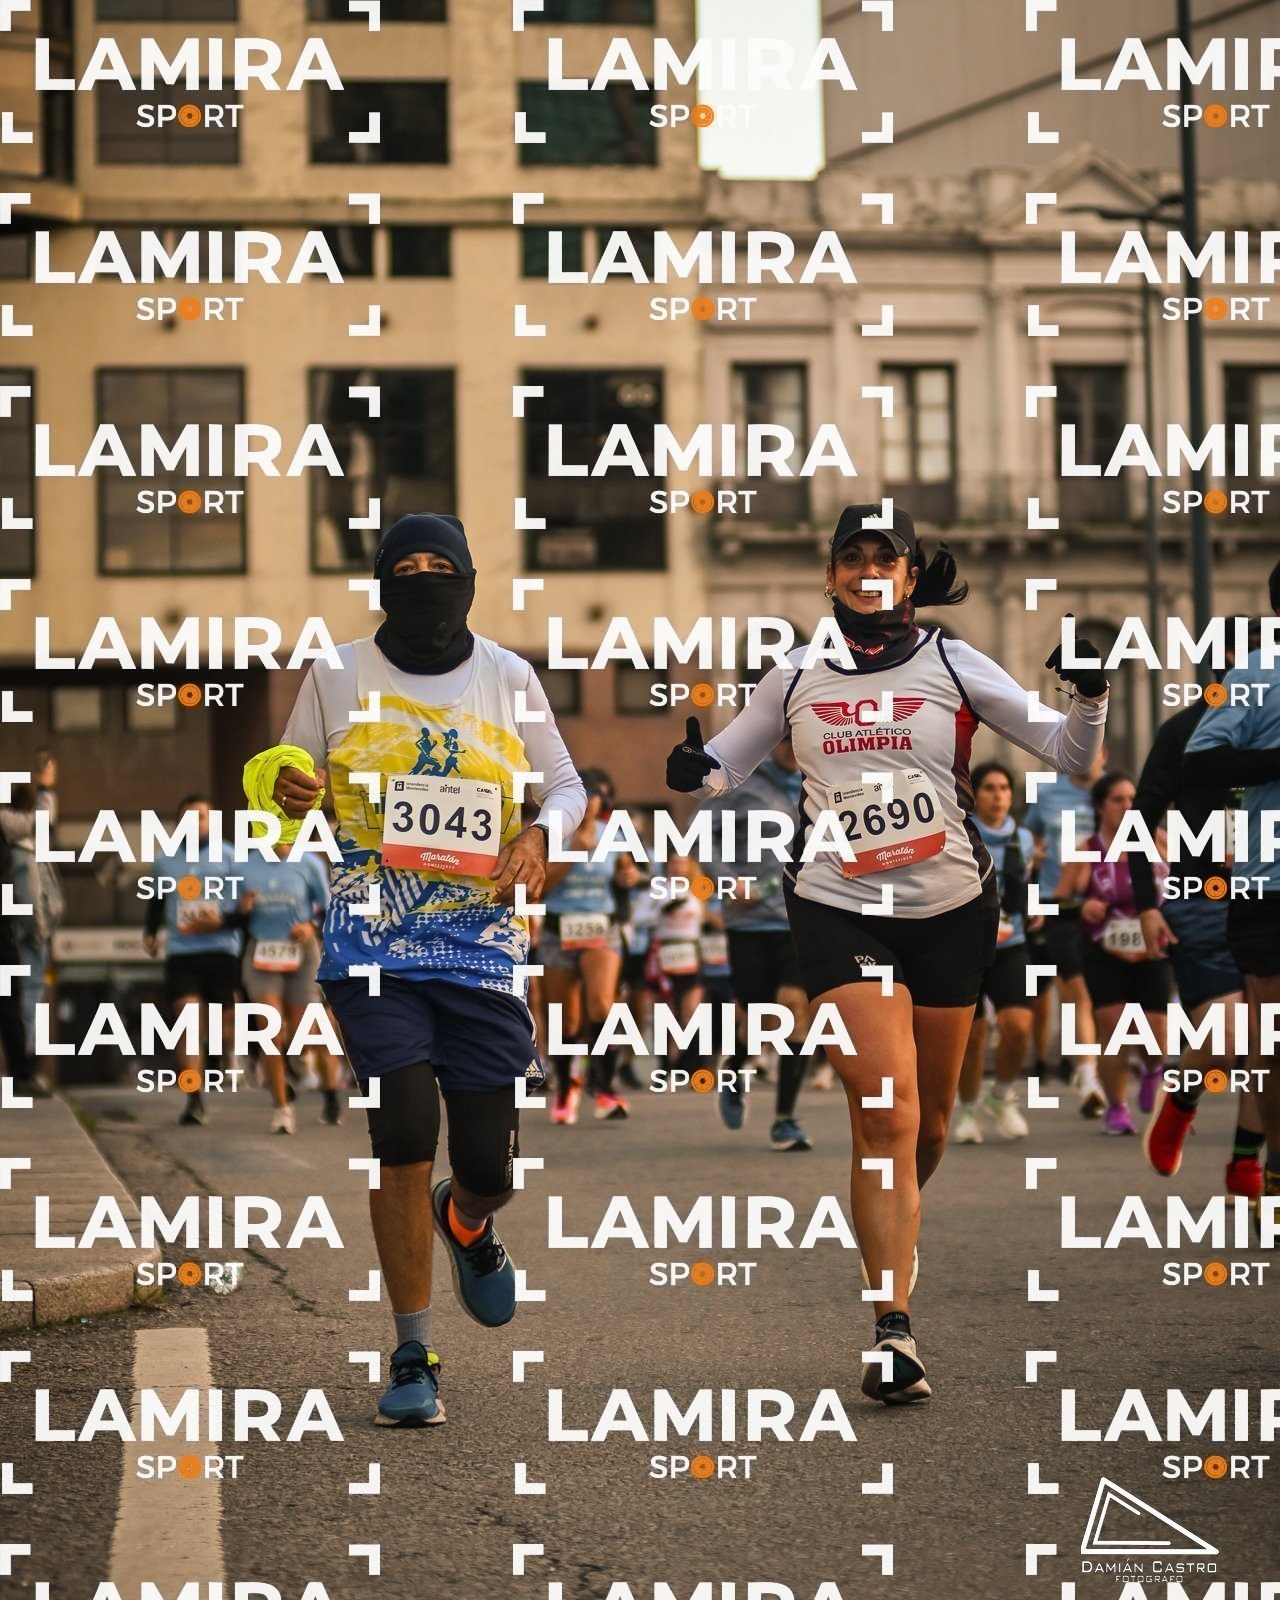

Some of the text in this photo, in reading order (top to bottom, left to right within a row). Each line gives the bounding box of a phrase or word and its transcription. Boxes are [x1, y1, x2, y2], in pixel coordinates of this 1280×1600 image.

[823, 727, 912, 740] CLUB ATLÉTICO
[822, 736, 913, 755] OLIMPIA
[392, 800, 492, 842] 3043
[838, 792, 935, 842] 2690
[420, 851, 460, 866] Maratón
[876, 846, 915, 862] Maratón
[1109, 931, 1141, 947] 198
